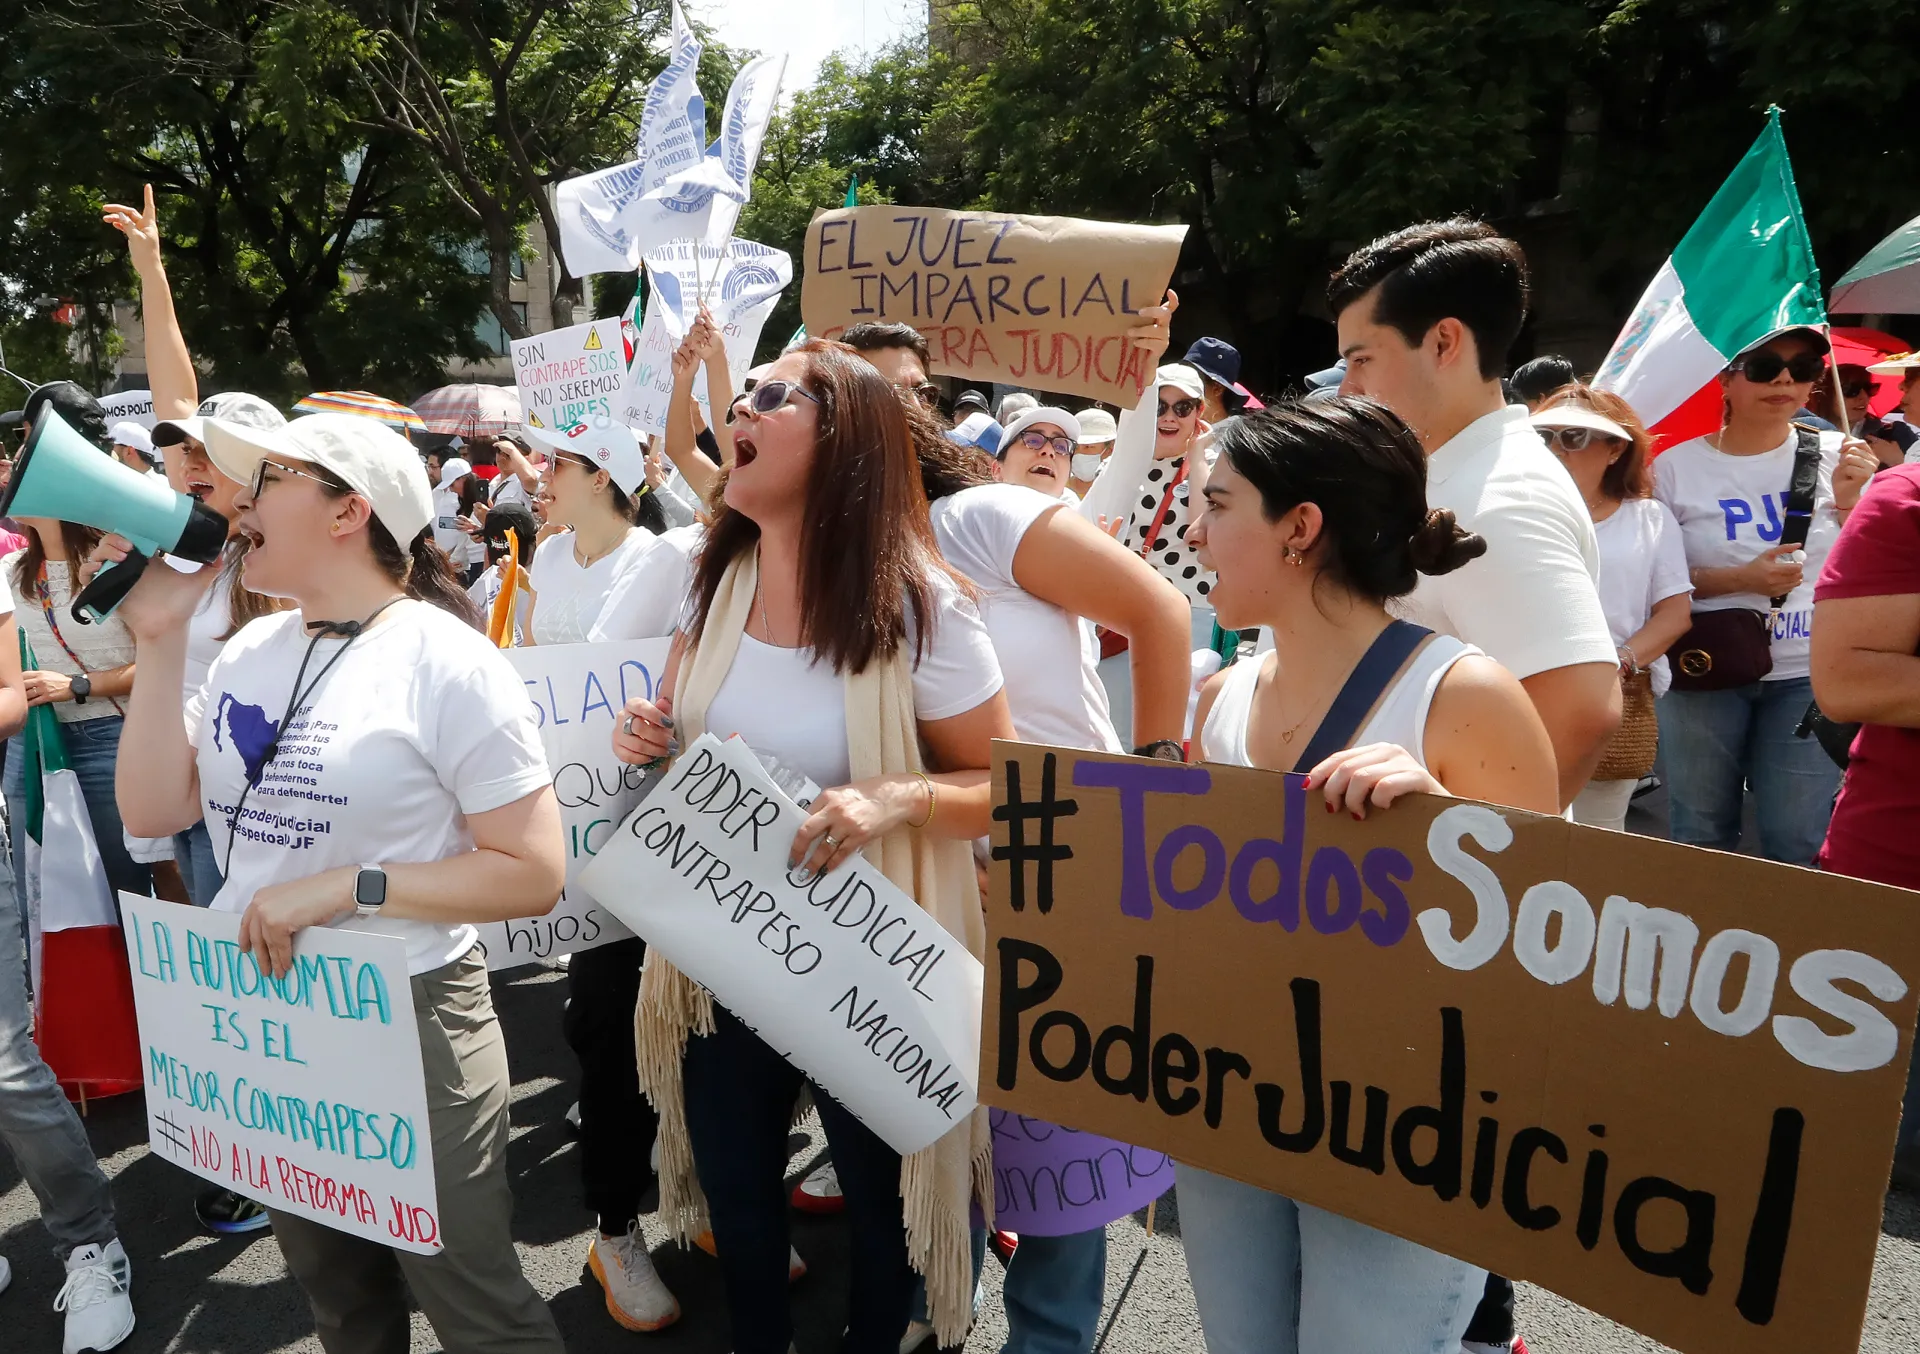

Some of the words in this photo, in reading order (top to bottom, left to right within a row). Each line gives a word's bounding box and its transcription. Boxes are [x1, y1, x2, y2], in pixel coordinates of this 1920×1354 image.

[818, 219, 873, 273] EL
[886, 216, 1017, 269] JUEZ
[851, 270, 1143, 325] IMPARCIAL
[518, 342, 545, 367] SIN
[533, 387, 552, 407] NO
[560, 373, 621, 402] SEREMOS
[313, 734, 331, 744] tus
[264, 772, 317, 786] defendernos
[280, 760, 295, 768] nos
[298, 760, 324, 772] toca
[257, 786, 275, 796] para
[277, 787, 348, 806] defenderte!
[670, 748, 781, 853] PODER
[132, 912, 178, 983] LA
[505, 910, 600, 958] hijos
[631, 806, 823, 977] CONTRAPESO
[829, 985, 964, 1121] NACIONAL
[261, 1019, 308, 1066] EL
[149, 1046, 231, 1122] MEJOR
[233, 1077, 417, 1171] CONTRAPESO
[232, 1142, 243, 1183] A
[245, 1148, 273, 1195] LA
[275, 1156, 379, 1227] REFORMA
[388, 1196, 441, 1249] JUD.
